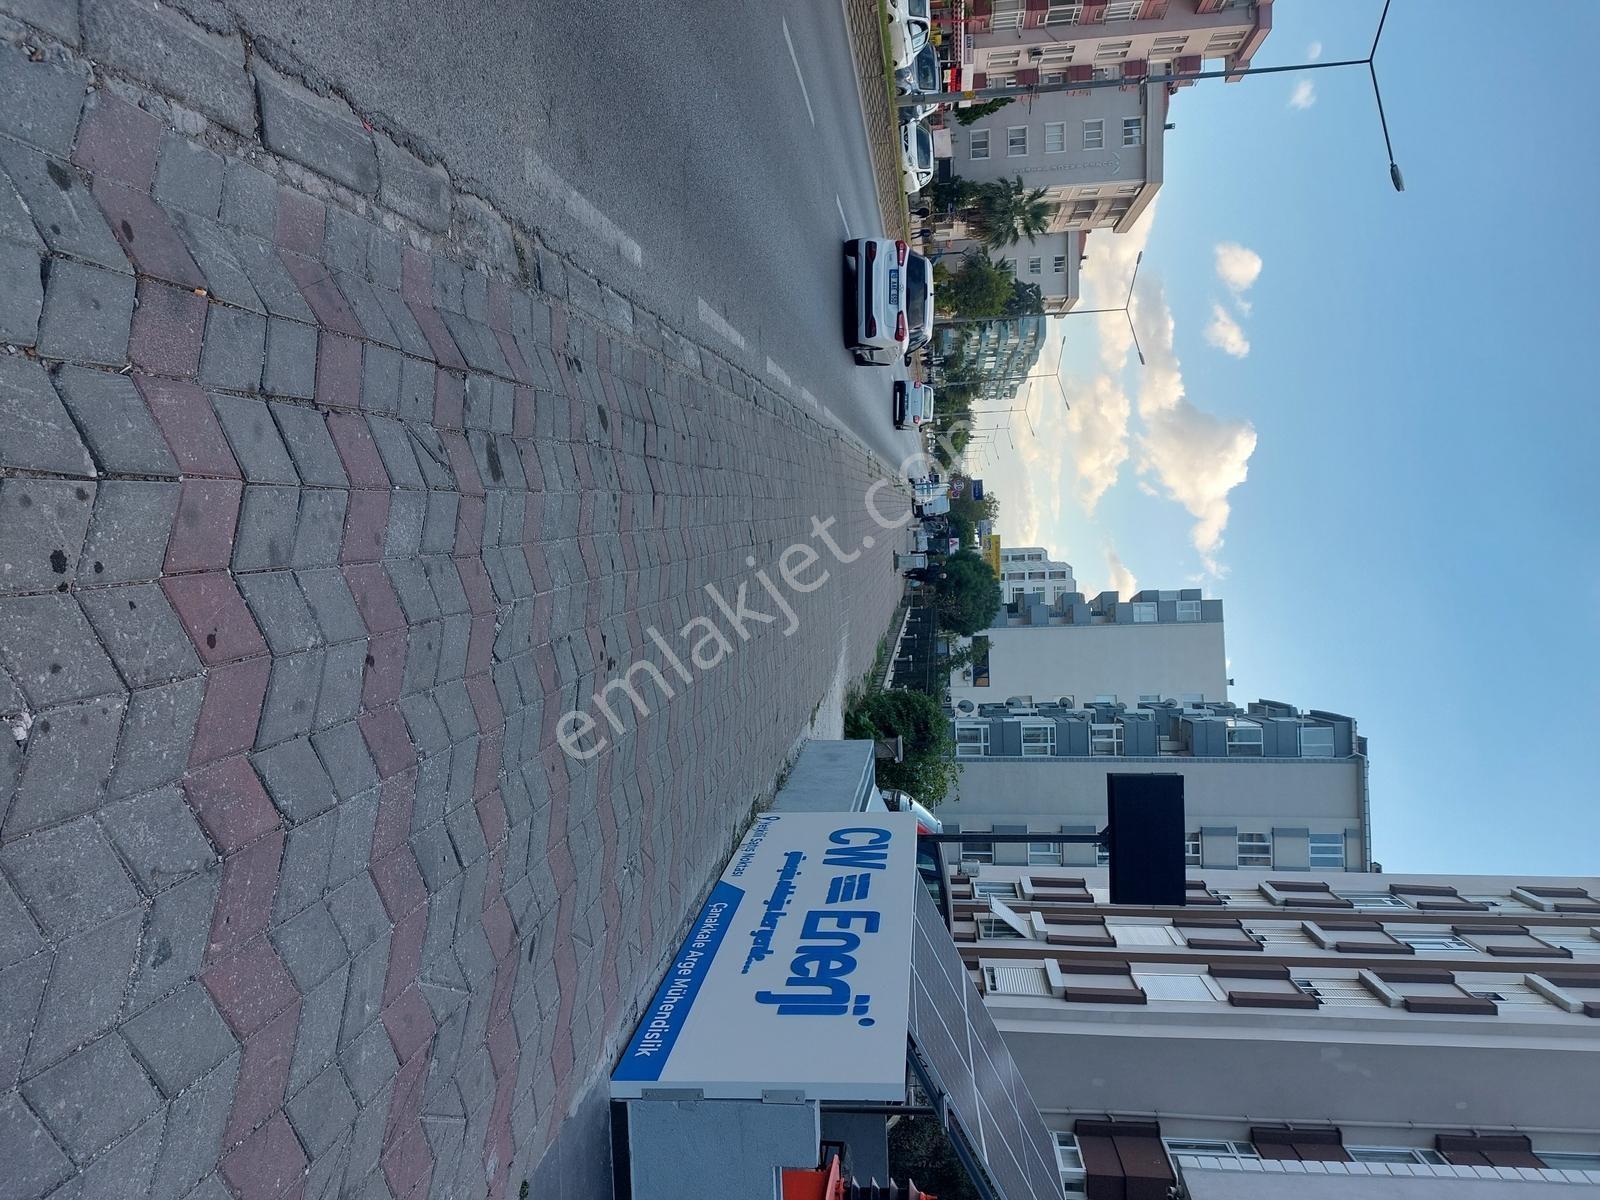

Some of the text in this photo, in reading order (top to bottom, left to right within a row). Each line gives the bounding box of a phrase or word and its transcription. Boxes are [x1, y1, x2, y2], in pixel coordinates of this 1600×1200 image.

[731, 853, 755, 877] Noktası
[753, 821, 771, 837] Yetkili
[755, 827, 892, 1015] CW Enerji
[635, 902, 728, 1057] Çanakkale Arge Mühendislik
